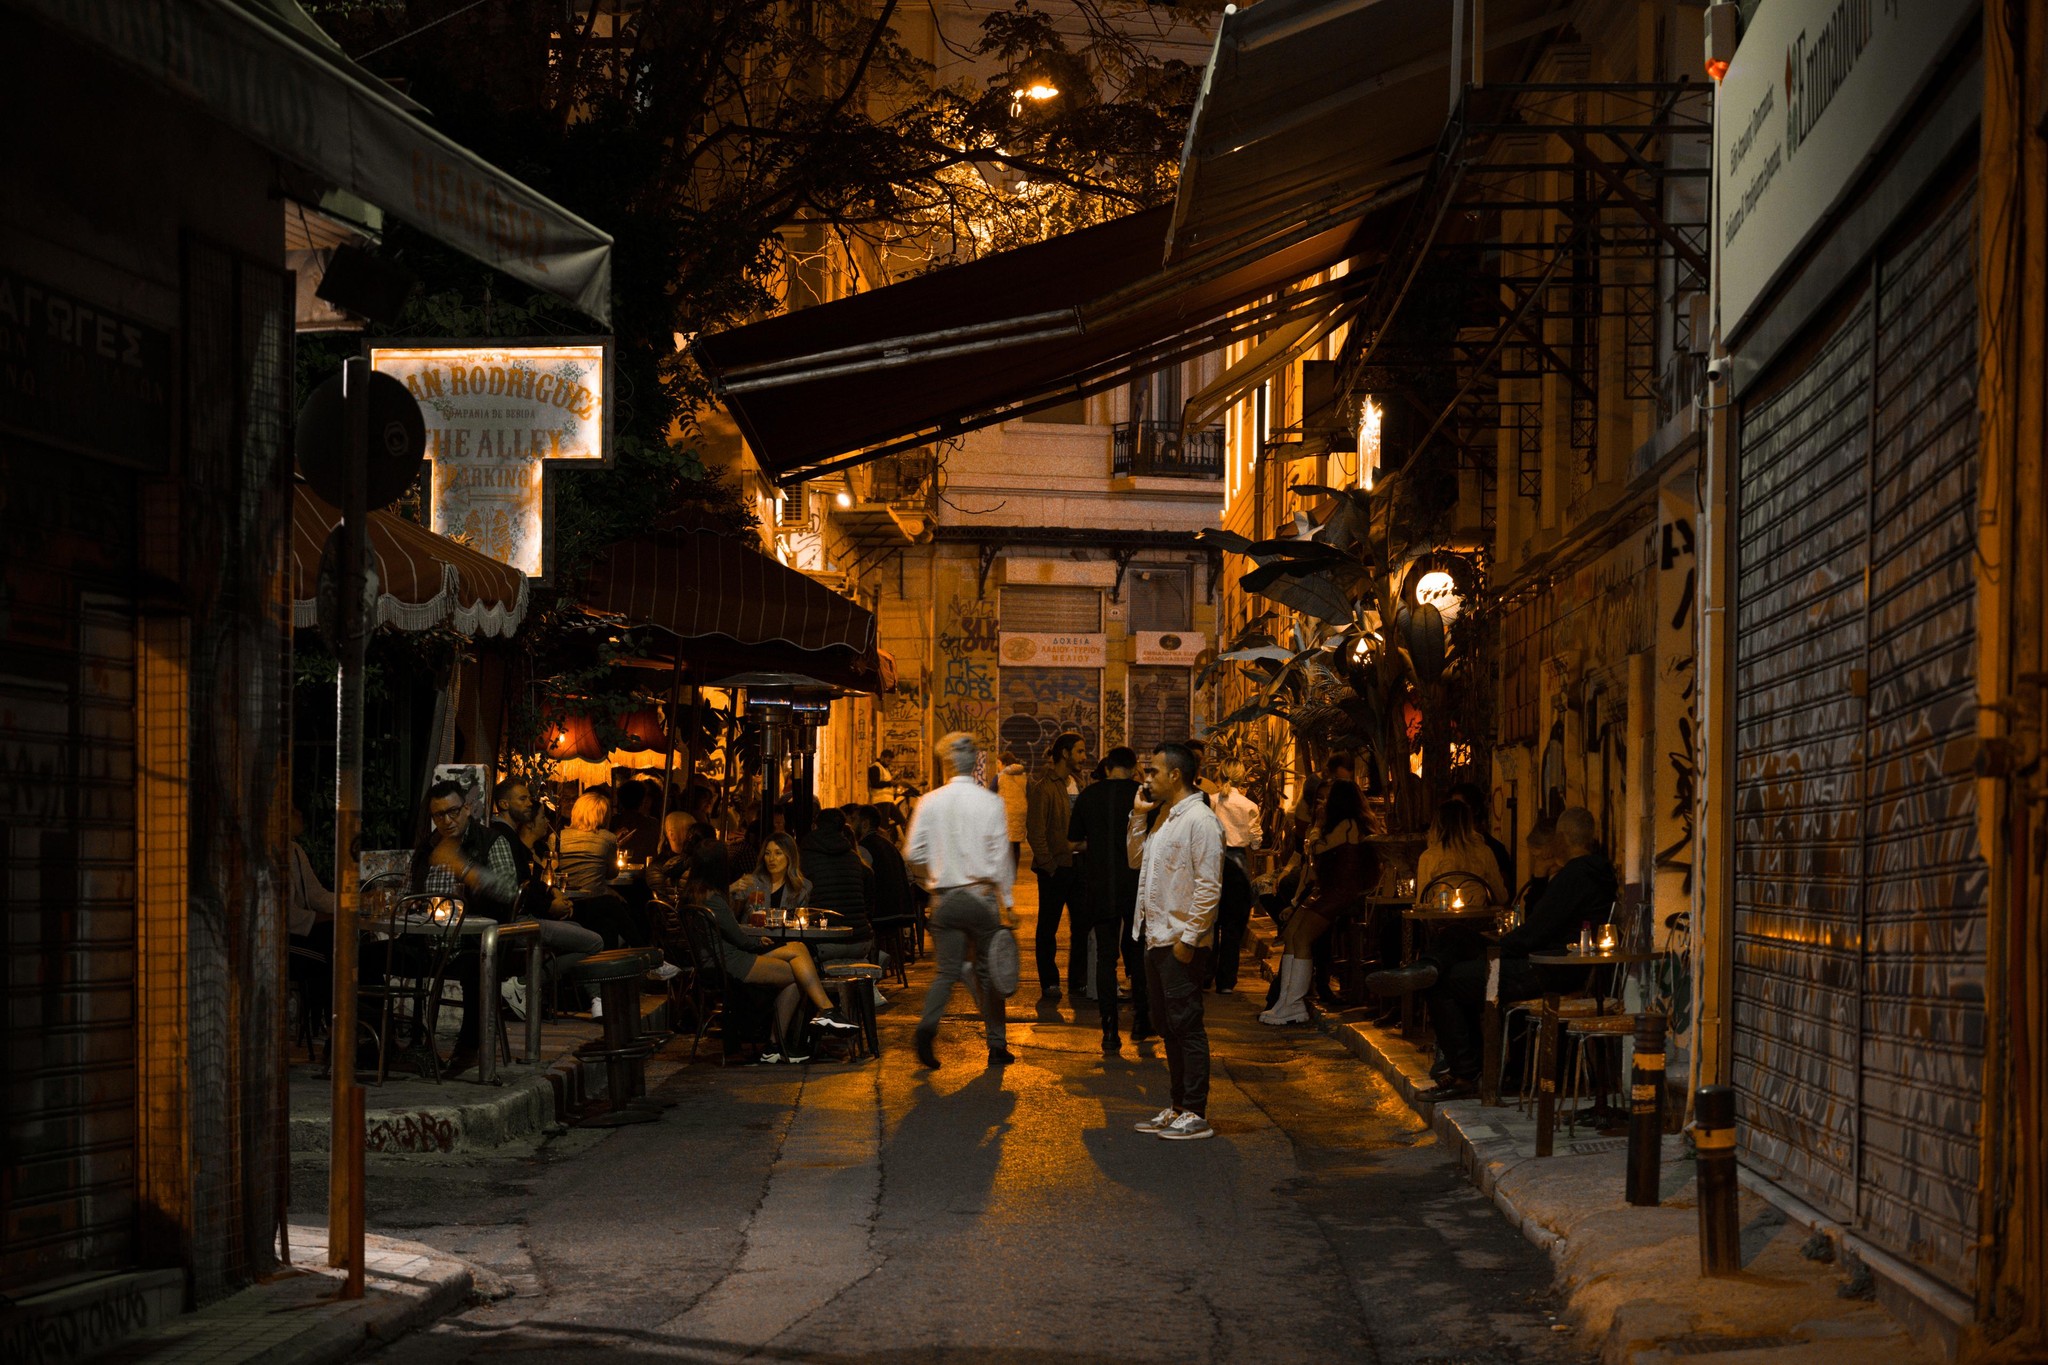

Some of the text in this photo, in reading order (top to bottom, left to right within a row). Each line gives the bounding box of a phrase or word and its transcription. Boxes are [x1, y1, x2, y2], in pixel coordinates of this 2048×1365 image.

[406, 365, 444, 400] AN
[492, 408, 502, 419] DE
[505, 408, 535, 419] BEBIDA
[476, 428, 563, 458] ALLEY
[444, 465, 528, 488] PARKING
[1053, 637, 1090, 645] ΔΟΧΕΙΑ
